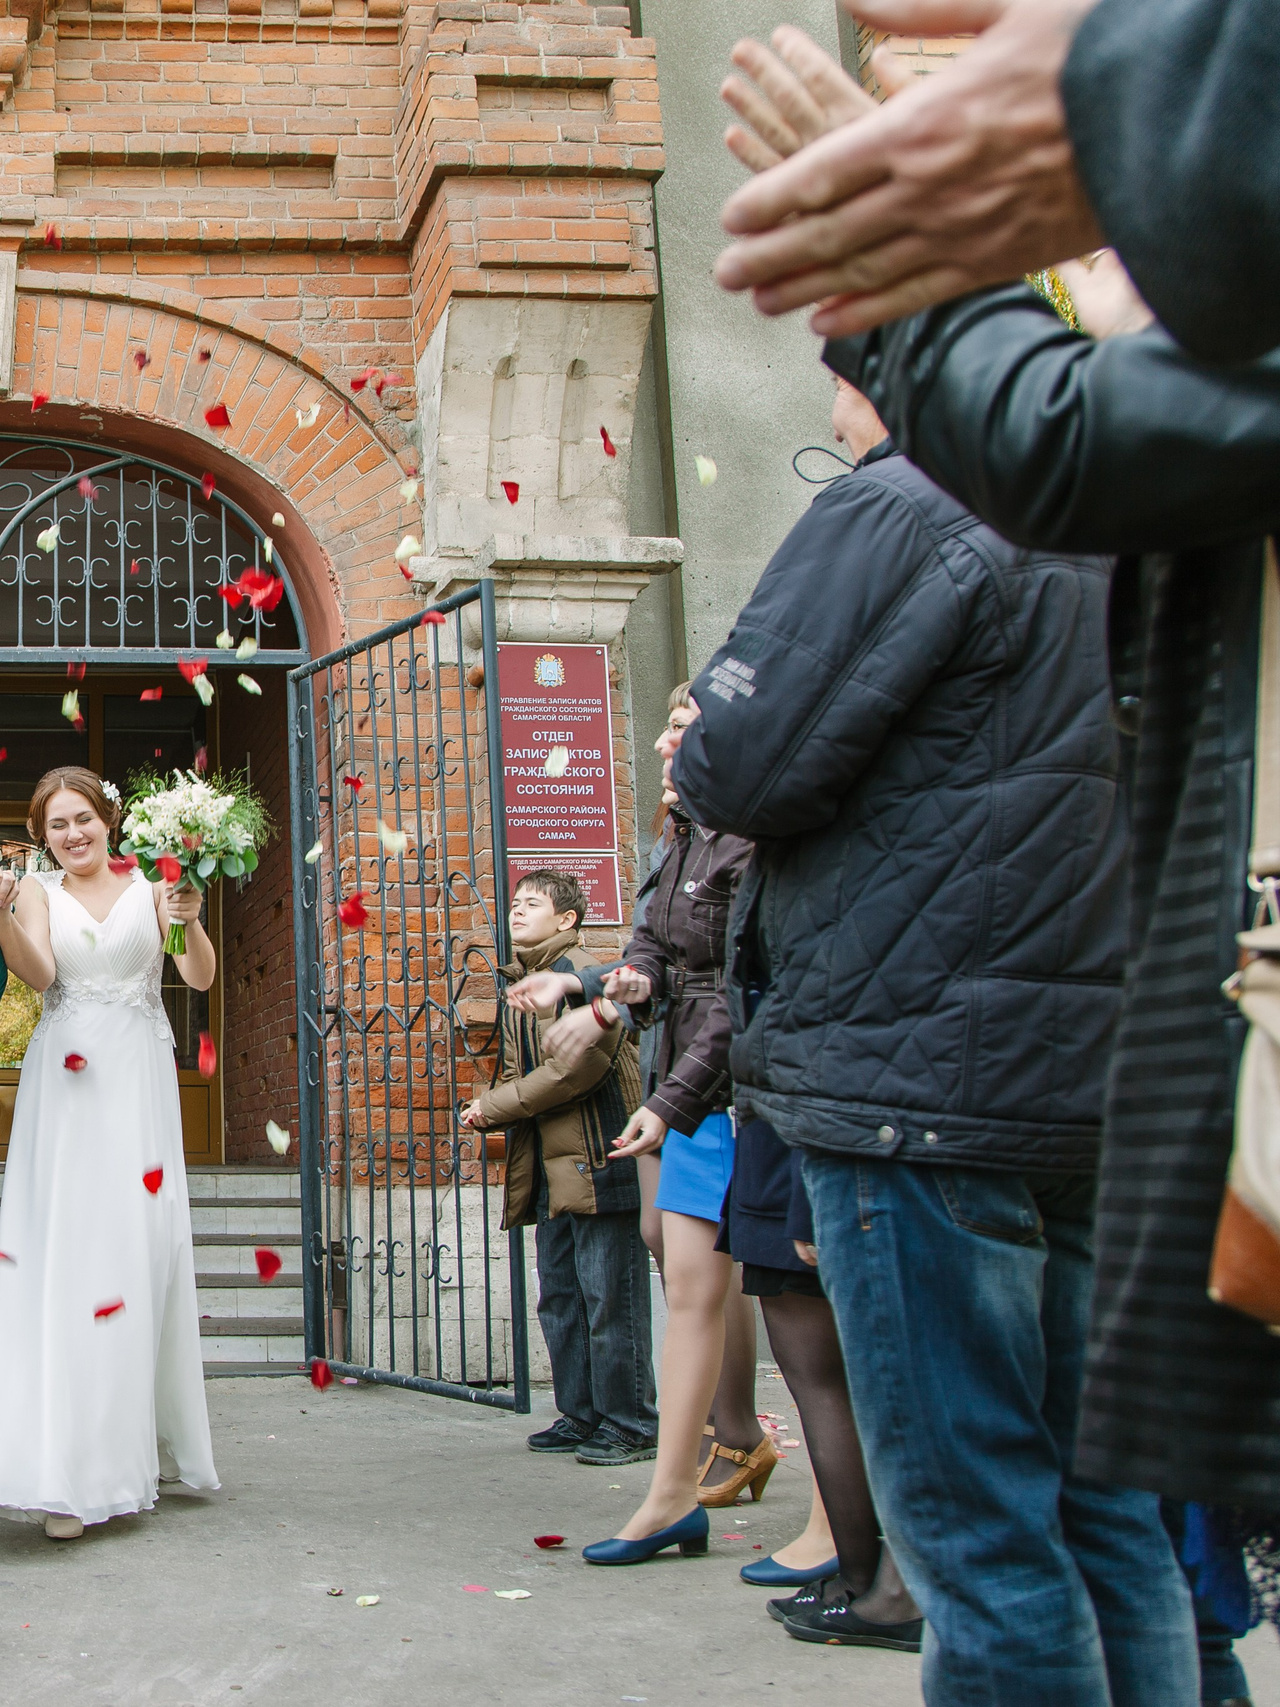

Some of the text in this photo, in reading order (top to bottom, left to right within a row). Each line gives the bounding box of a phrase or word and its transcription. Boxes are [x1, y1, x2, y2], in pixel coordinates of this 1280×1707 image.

[532, 731, 574, 743] ОТДЕЛ
[569, 749, 601, 759] КТОВ
[504, 766, 605, 778] ГРАЖДСКОГО
[516, 784, 594, 795] СОСТОЯНИЯ
[505, 805, 607, 814] САМАРСКОГО РАЙОНА
[508, 819, 569, 828] ГОРОДСКОГО
